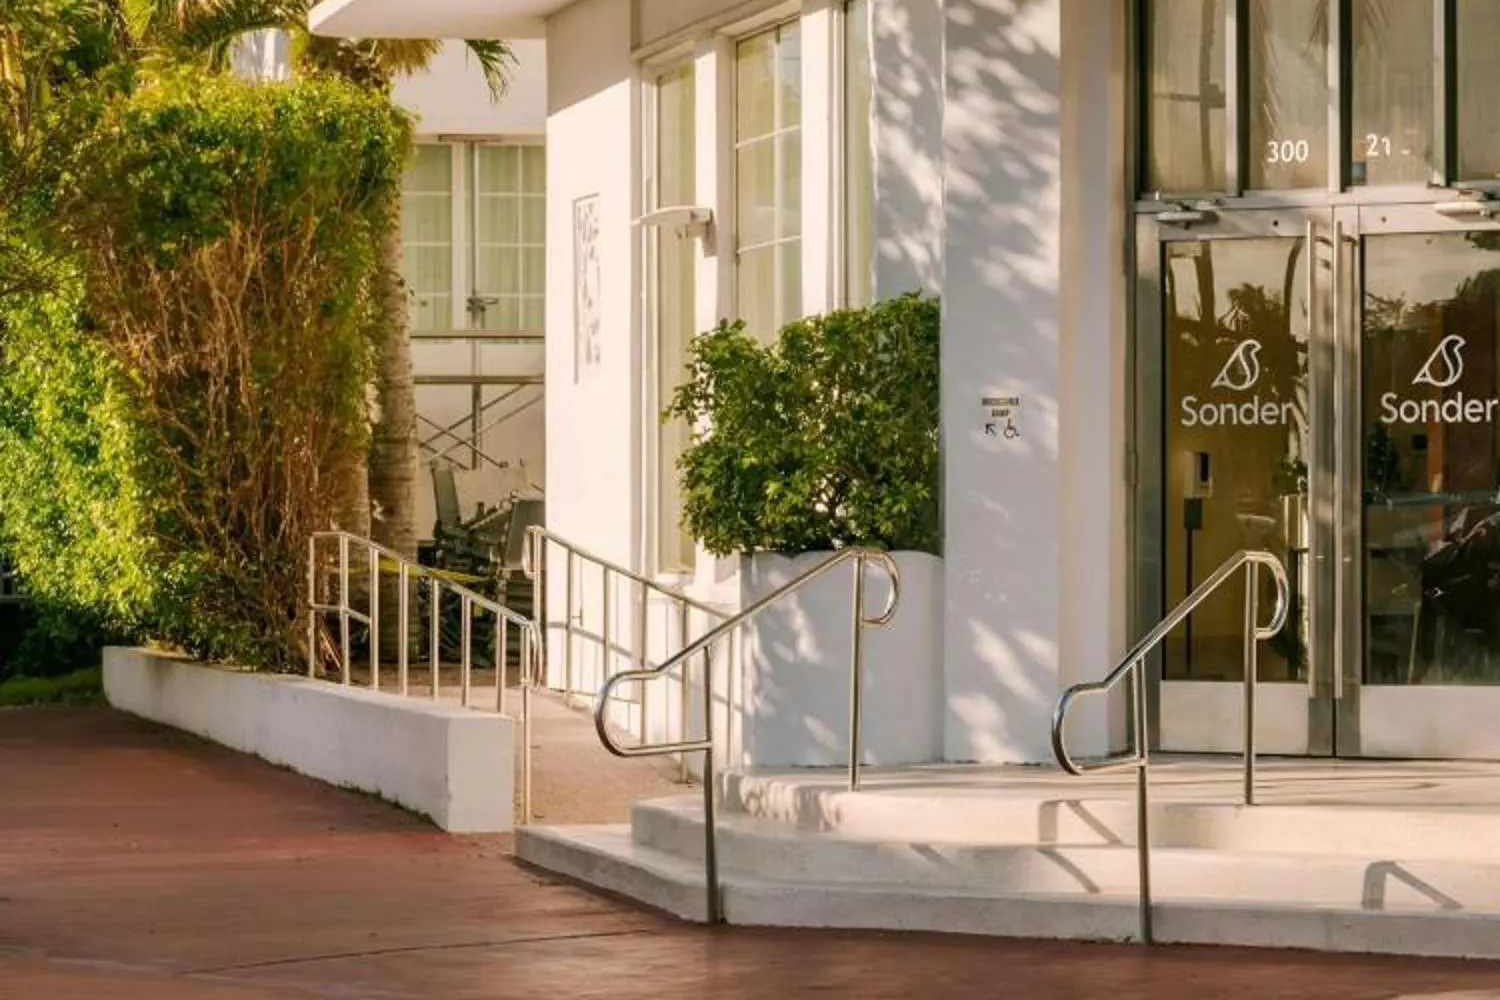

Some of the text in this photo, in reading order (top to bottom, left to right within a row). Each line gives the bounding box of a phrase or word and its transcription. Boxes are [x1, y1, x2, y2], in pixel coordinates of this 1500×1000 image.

[1267, 139, 1309, 163] 300
[1181, 395, 1294, 427] Sonder
[1380, 391, 1499, 423] Sonder
